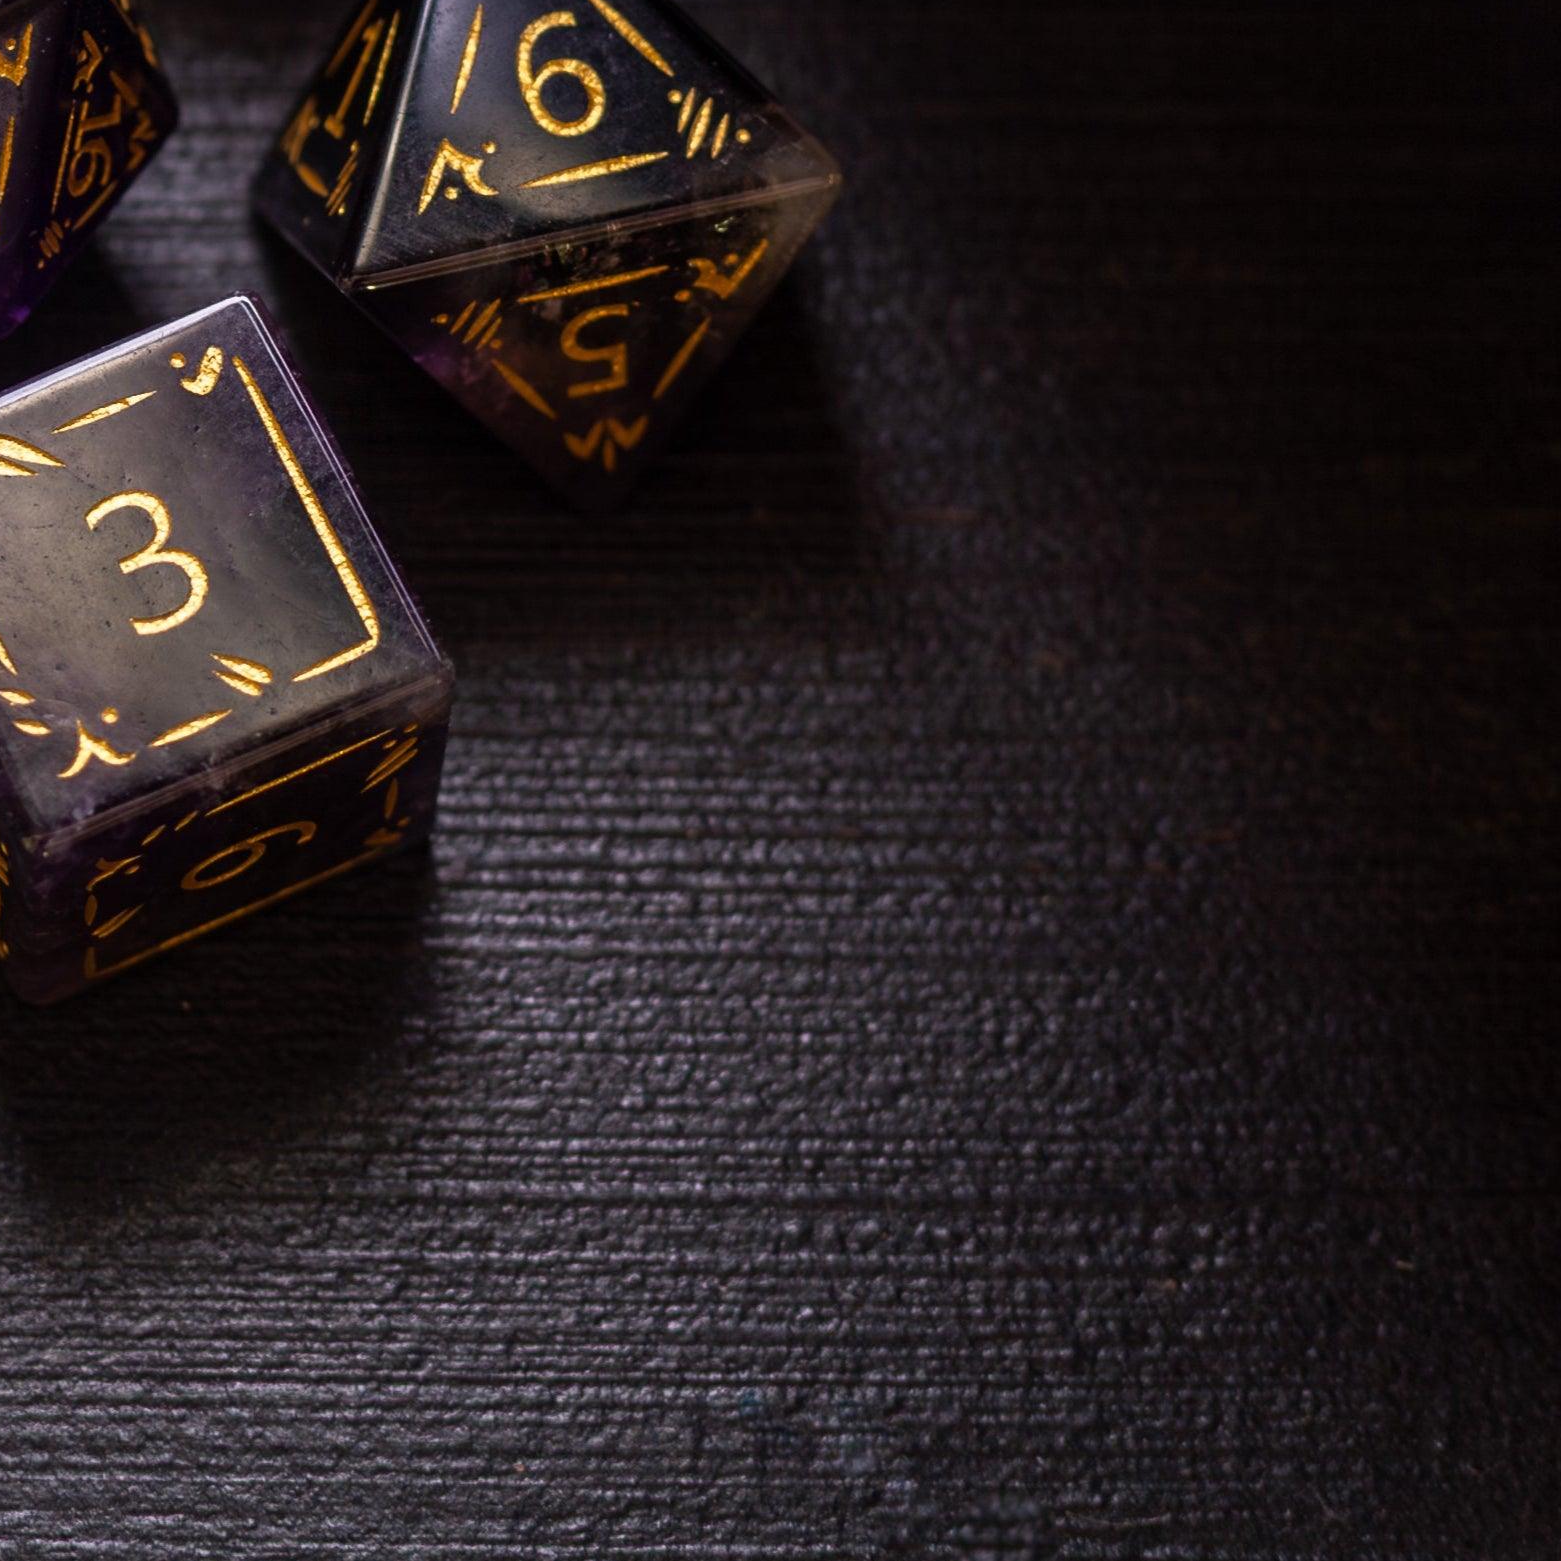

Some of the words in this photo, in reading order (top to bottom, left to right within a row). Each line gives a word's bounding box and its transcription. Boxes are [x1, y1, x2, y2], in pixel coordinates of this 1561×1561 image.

[517, 10, 606, 137] 6
[559, 303, 630, 398] 5
[84, 490, 208, 635] 3
